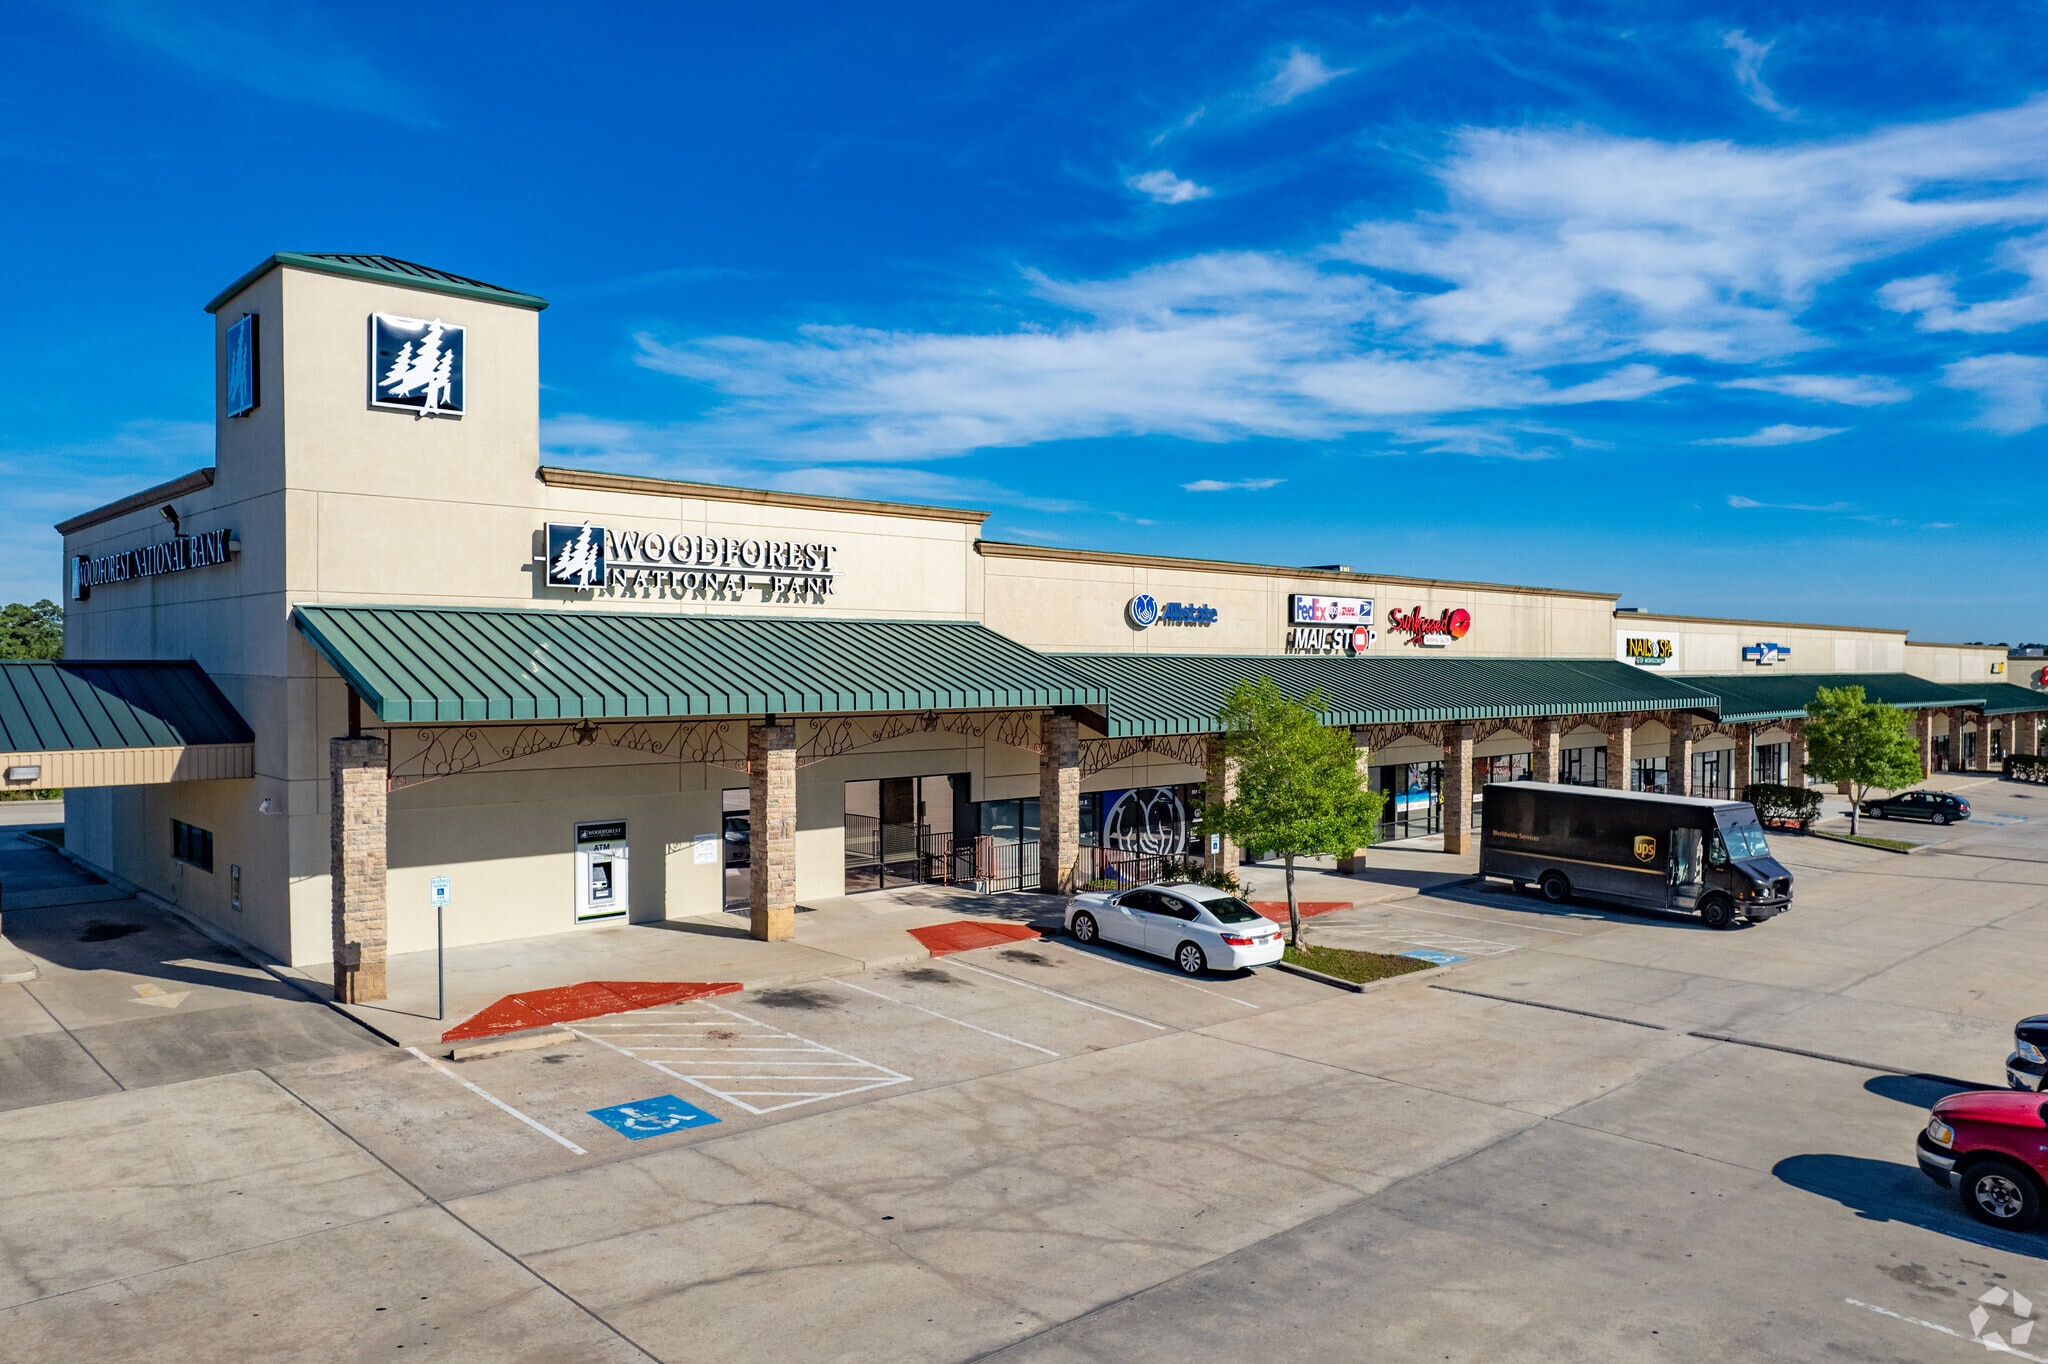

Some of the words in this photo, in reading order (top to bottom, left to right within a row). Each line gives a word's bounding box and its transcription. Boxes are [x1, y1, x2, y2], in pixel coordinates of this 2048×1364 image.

[134, 539, 186, 577] NATIONAL
[191, 529, 226, 568] BANK
[607, 528, 838, 570] WOODFOREST
[609, 568, 754, 592] NATIONAL
[773, 576, 836, 595] BANK
[1162, 602, 1218, 623] Allstate
[1296, 596, 1327, 622] FedEx
[1393, 605, 1450, 645] Sunkissed
[1295, 628, 1331, 650] MAIL
[1629, 638, 1653, 657] NAILS
[1660, 639, 1673, 657] SPA
[588, 827, 622, 836] WOODFOREST
[1492, 828, 1519, 839] Worldwide
[1519, 832, 1540, 842] Services
[594, 843, 611, 852] ATM
[1635, 843, 1655, 859] ups
